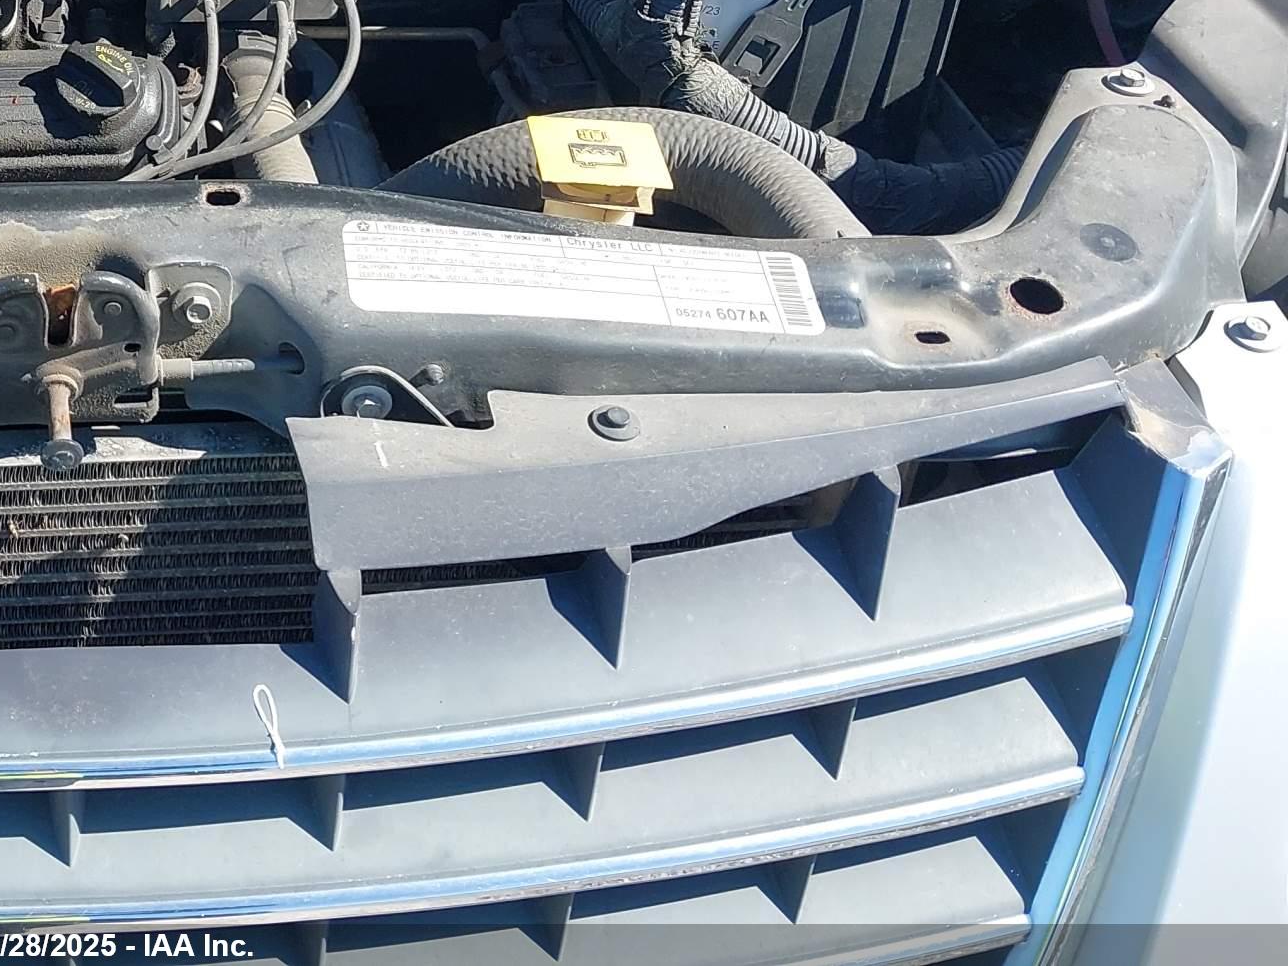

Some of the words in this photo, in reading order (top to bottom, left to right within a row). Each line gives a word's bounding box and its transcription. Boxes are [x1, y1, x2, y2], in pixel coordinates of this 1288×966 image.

[95, 45, 127, 63] ENGINE
[123, 62, 136, 77] OIL
[383, 224, 417, 233] VEHICLE
[420, 226, 459, 236] EMISSION
[462, 229, 495, 238] CONTROL
[500, 233, 552, 243] INFORMATION
[566, 237, 623, 251] Chrysler
[630, 240, 654, 252] LLC
[675, 307, 712, 320] 05274
[715, 307, 771, 324] 607AA
